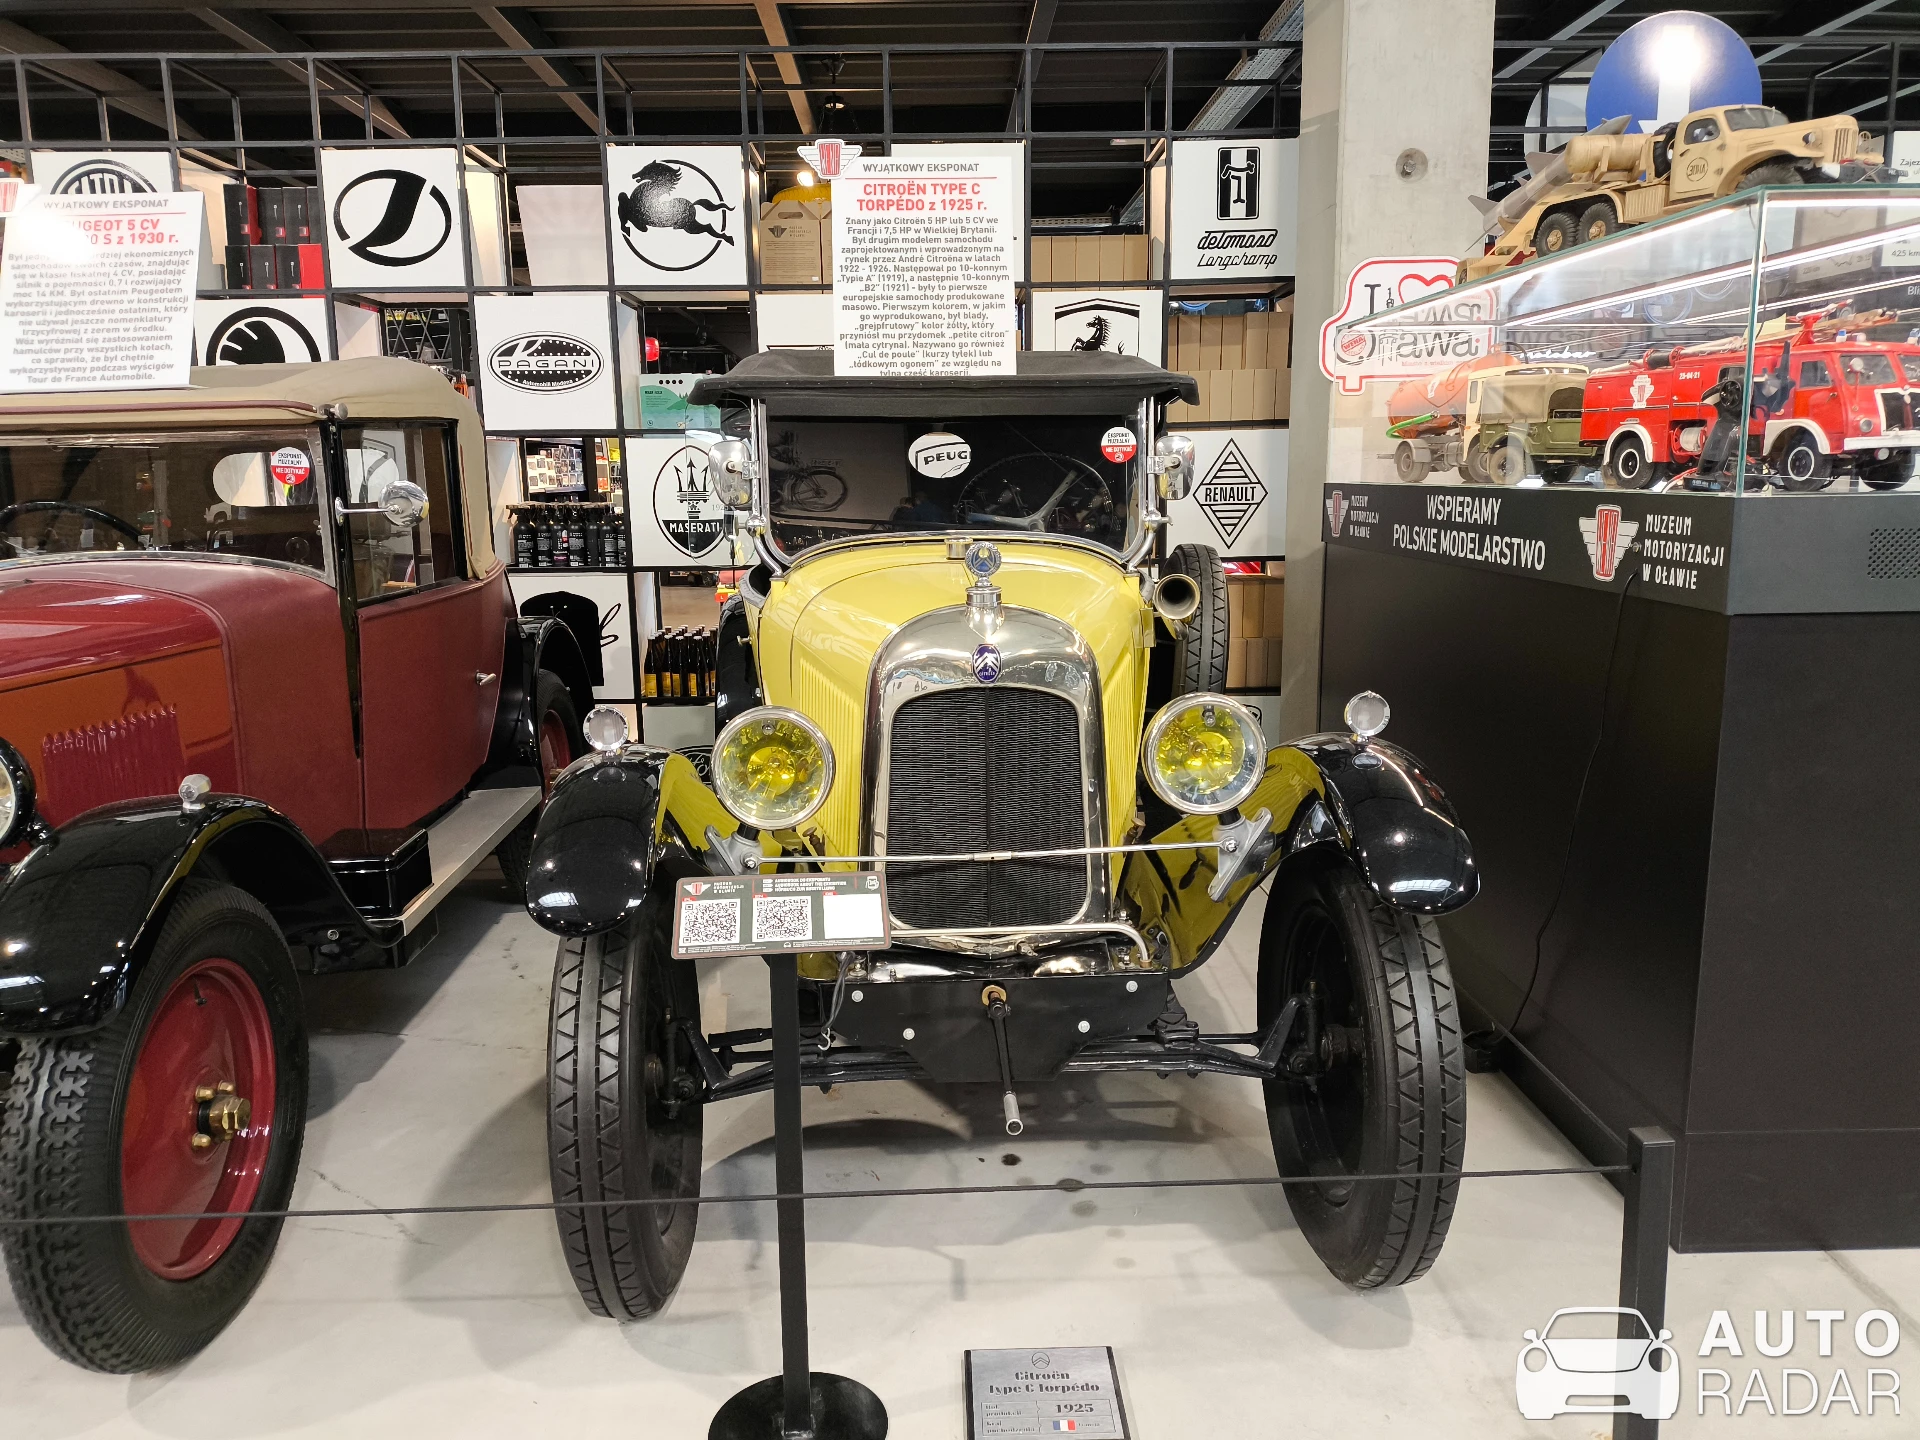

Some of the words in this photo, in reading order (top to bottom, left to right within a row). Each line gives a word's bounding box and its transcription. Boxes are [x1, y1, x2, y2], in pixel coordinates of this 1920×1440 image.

[862, 163, 924, 172] WYJĄTKOWY
[927, 163, 979, 172] EKSPONAT
[863, 181, 926, 196] CITROËN
[930, 183, 967, 195] TYPE
[971, 183, 980, 195] C
[112, 200, 168, 208] EKSPONAT
[856, 197, 924, 211] TORPÉDO
[928, 202, 936, 211] z
[940, 198, 972, 211] 1925
[977, 201, 986, 211] r.
[127, 218, 135, 230] 5
[140, 218, 159, 230] CV
[845, 217, 871, 227] Znany
[873, 216, 891, 227] jako
[893, 216, 925, 225] Citroën
[927, 216, 932, 224] 5
[935, 216, 947, 224] HP
[949, 216, 963, 224] lub
[965, 216, 970, 224] 5
[972, 216, 984, 224] CV
[847, 226, 877, 236] Francji
[884, 226, 897, 236] 7,5
[899, 226, 911, 234] HP
[922, 226, 958, 236] Wielkiej
[960, 226, 996, 236] Brytanii.
[103, 234, 111, 245] S
[116, 236, 123, 245] z
[130, 232, 164, 244] 1930
[168, 234, 178, 244] r.
[852, 236, 866, 246] Był
[868, 236, 899, 246] drugim
[901, 236, 941, 244] modelem
[944, 236, 992, 244] samochodu
[841, 245, 917, 256] zaprojektowanym
[924, 245, 991, 255] wprowadzonym
[844, 255, 869, 265] rynek
[872, 257, 896, 265] przez
[898, 255, 924, 263] André
[926, 255, 962, 263] Citroëna
[974, 254, 1000, 262] latach
[1197, 252, 1278, 270] Longchamp
[839, 265, 859, 273] 1922
[868, 264, 891, 273] 1926.
[893, 264, 944, 274] Następował
[946, 266, 956, 274] po
[959, 264, 1007, 274] 10-konnym
[917, 274, 958, 284] następnie
[961, 273, 1009, 284] 10-konnym
[918, 283, 935, 293] były
[937, 283, 946, 291] to
[948, 283, 987, 293] pierwsze
[842, 293, 893, 303] europejskie
[895, 293, 944, 303] samochody
[946, 292, 1004, 303] produkowane
[882, 302, 929, 313] Pierwszym
[932, 302, 970, 312] kolorem,
[982, 302, 1005, 312] jakim
[859, 314, 870, 323] go
[872, 312, 945, 322] wyprodukowano,
[947, 312, 960, 322] był
[921, 321, 944, 329] kolor
[946, 321, 969, 331] żółty,
[971, 321, 994, 331] który
[839, 332, 879, 342] przyniósł
[898, 331, 945, 341] przydomek
[912, 340, 955, 350] Nazywano
[958, 342, 968, 350] go
[970, 340, 1004, 348] również
[878, 350, 889, 358] de
[979, 349, 992, 357] lub
[498, 359, 594, 369] PAGANI
[953, 359, 988, 370] względu
[1205, 486, 1257, 502] RENAULT
[1426, 494, 1501, 526] WSPIERAMY
[669, 522, 720, 533] MASERATI
[1645, 514, 1692, 536] MUZEUM
[1393, 526, 1437, 554] POLSKIE
[1440, 528, 1546, 571] MODELARSTWO
[1643, 538, 1725, 567] MOTORYZACJI
[1642, 563, 1651, 582] W
[1655, 565, 1698, 590] OŁAWIE
[1015, 1371, 1070, 1381] Citroën
[988, 1383, 1022, 1396] Type
[1025, 1384, 1035, 1393] C
[1038, 1382, 1100, 1395] Torpédo
[1054, 1403, 1095, 1414] 1925
